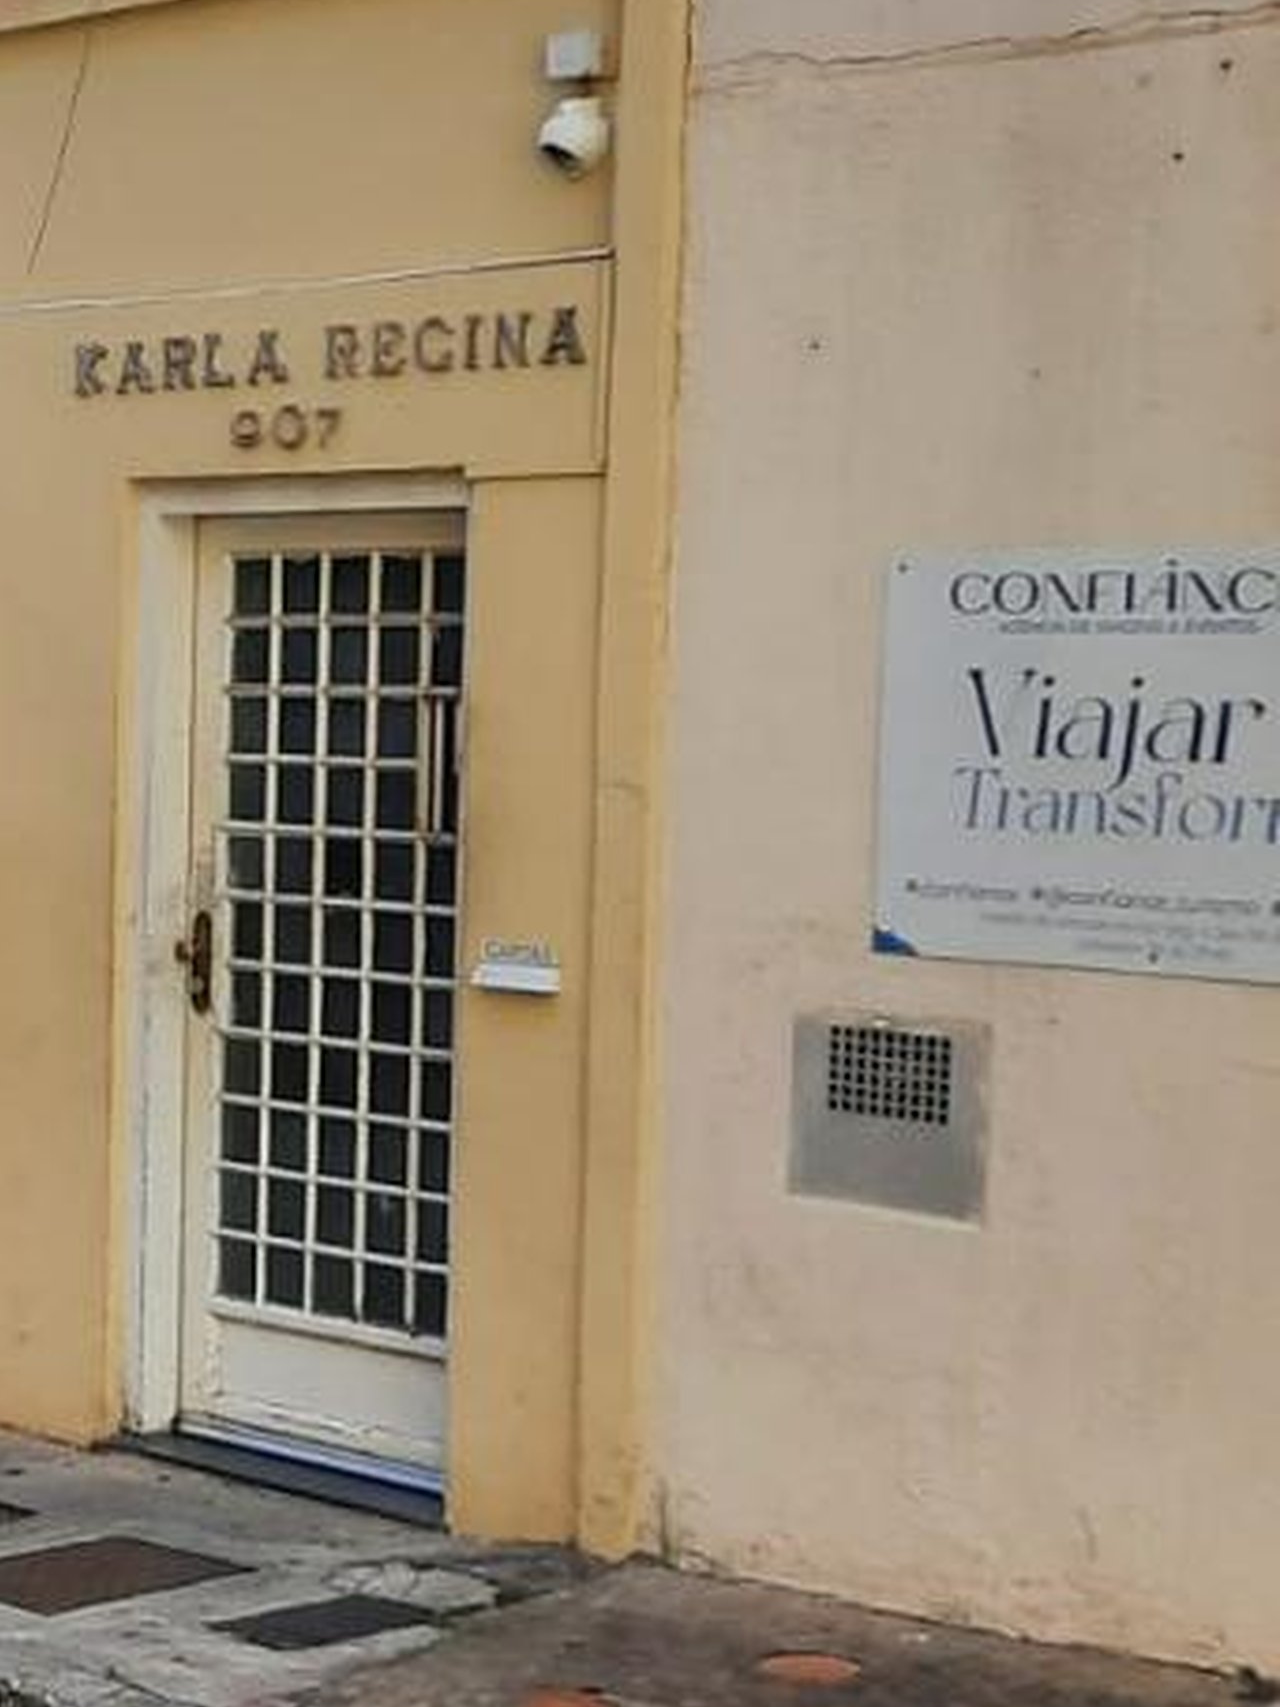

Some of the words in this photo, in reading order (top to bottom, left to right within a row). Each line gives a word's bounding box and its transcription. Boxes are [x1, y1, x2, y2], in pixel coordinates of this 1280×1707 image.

[72, 330, 288, 398] KARLA
[231, 405, 342, 450] 907
[967, 667, 1265, 793] Viajar
